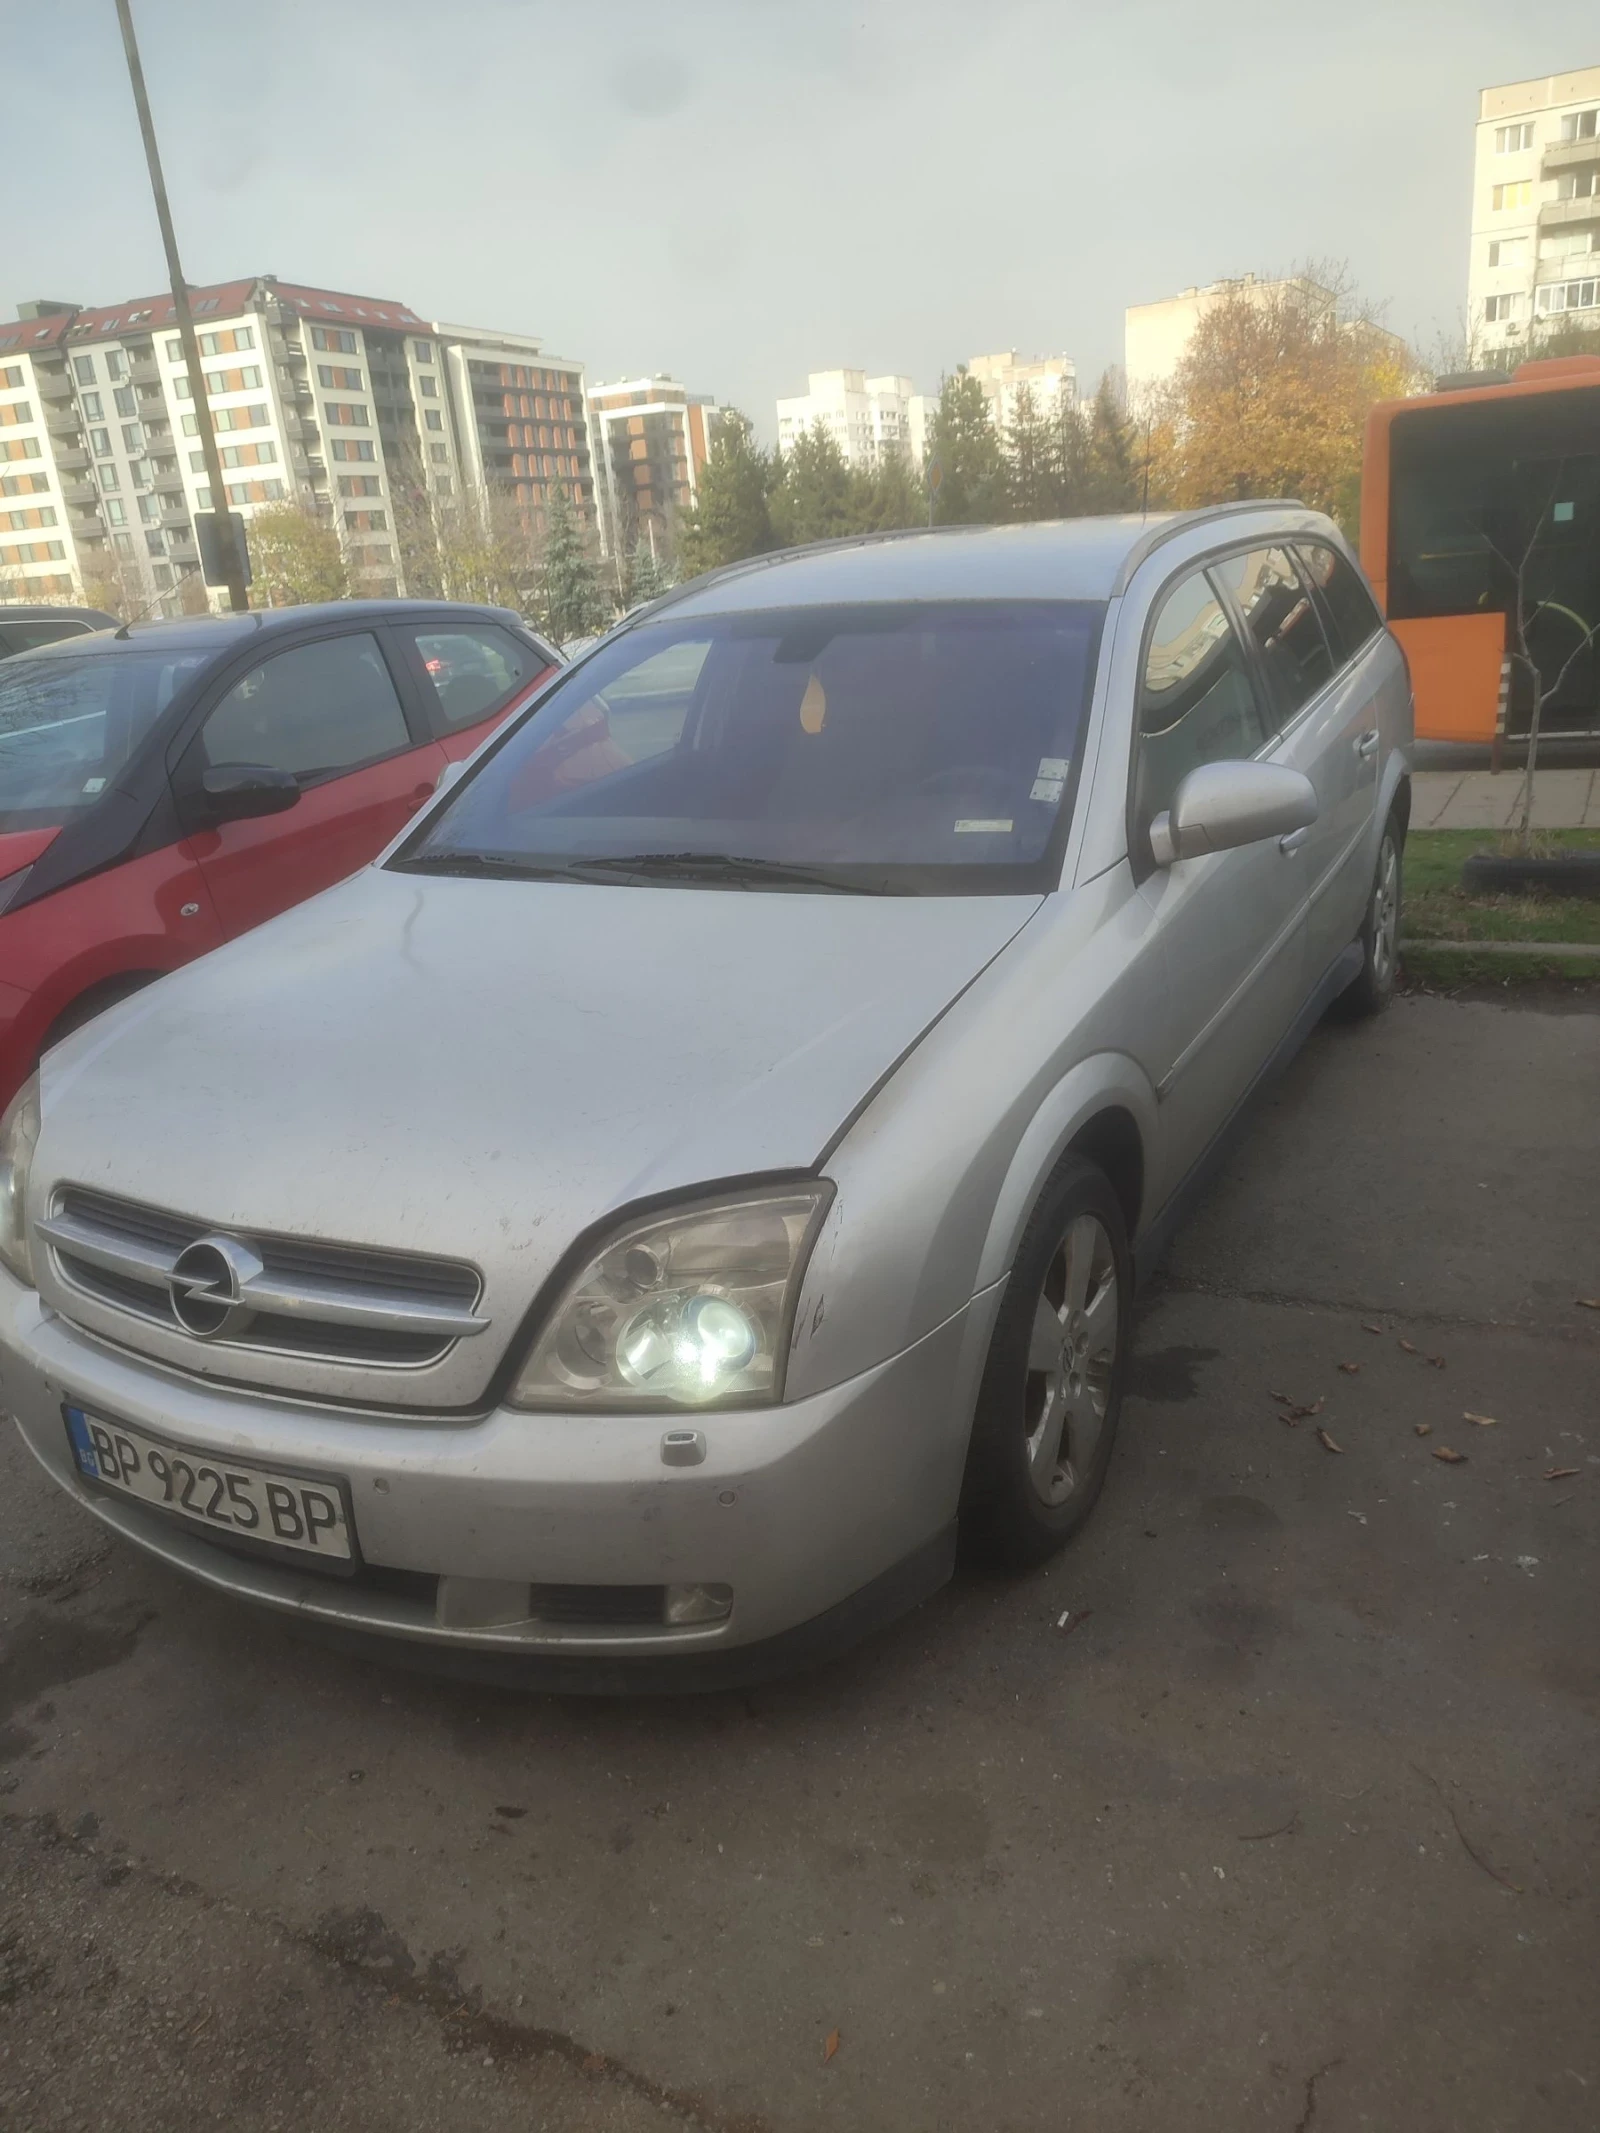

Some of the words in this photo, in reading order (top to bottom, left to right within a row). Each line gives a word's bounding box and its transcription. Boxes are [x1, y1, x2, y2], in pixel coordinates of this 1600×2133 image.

[90, 1424, 140, 1485] BP
[148, 1450, 258, 1528] 9225
[265, 1482, 336, 1544] BP
